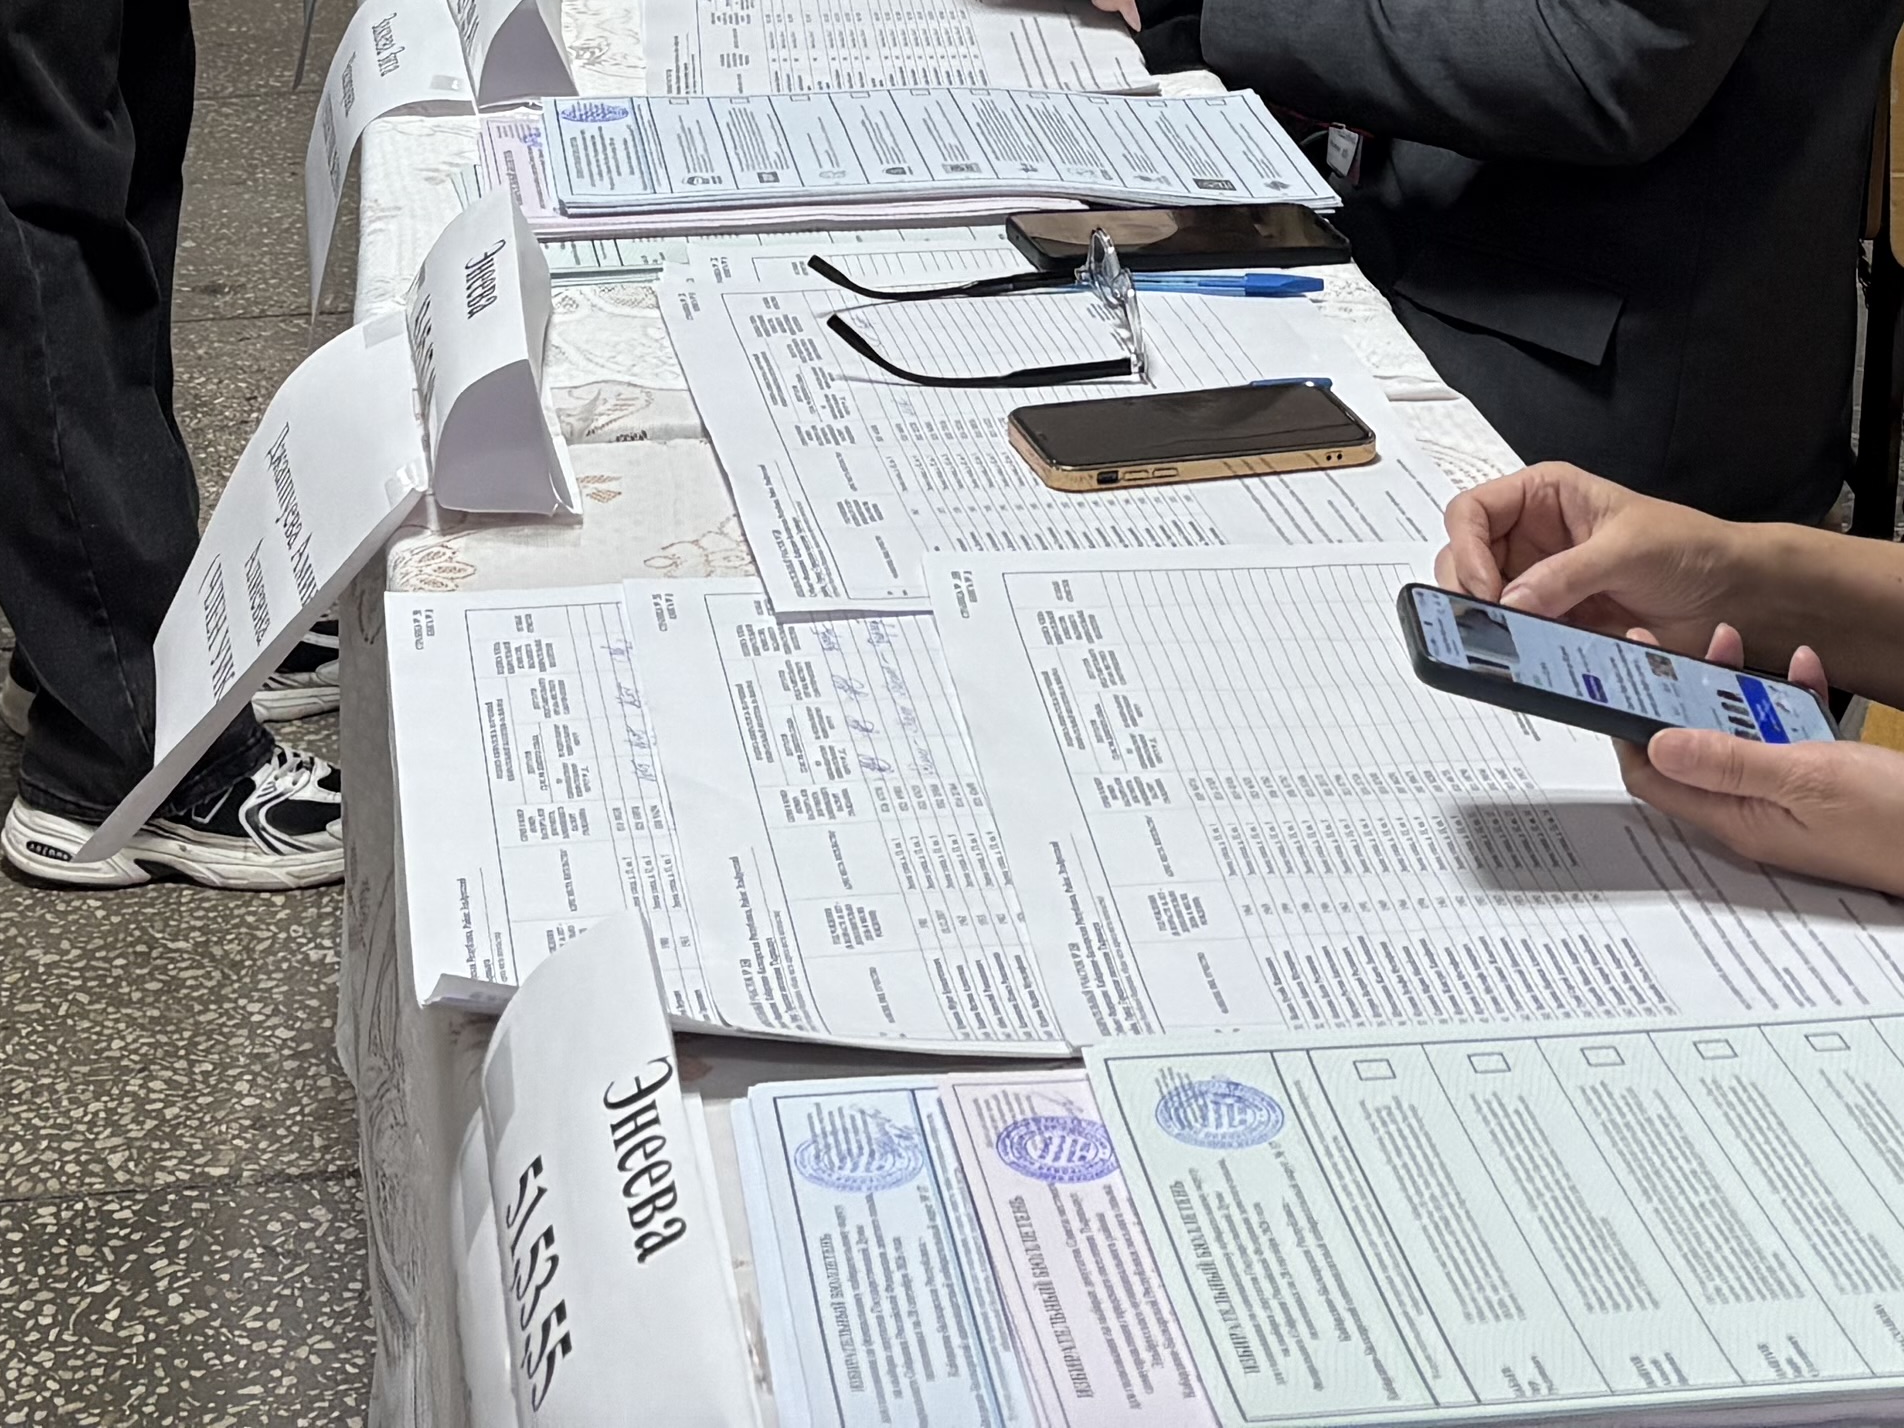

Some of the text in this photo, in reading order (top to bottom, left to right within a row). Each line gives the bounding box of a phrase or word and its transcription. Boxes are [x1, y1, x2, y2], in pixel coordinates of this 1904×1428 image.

[465, 239, 507, 321] Энеева
[244, 537, 272, 647] Алиевна
[603, 1055, 688, 1265] Энеева
